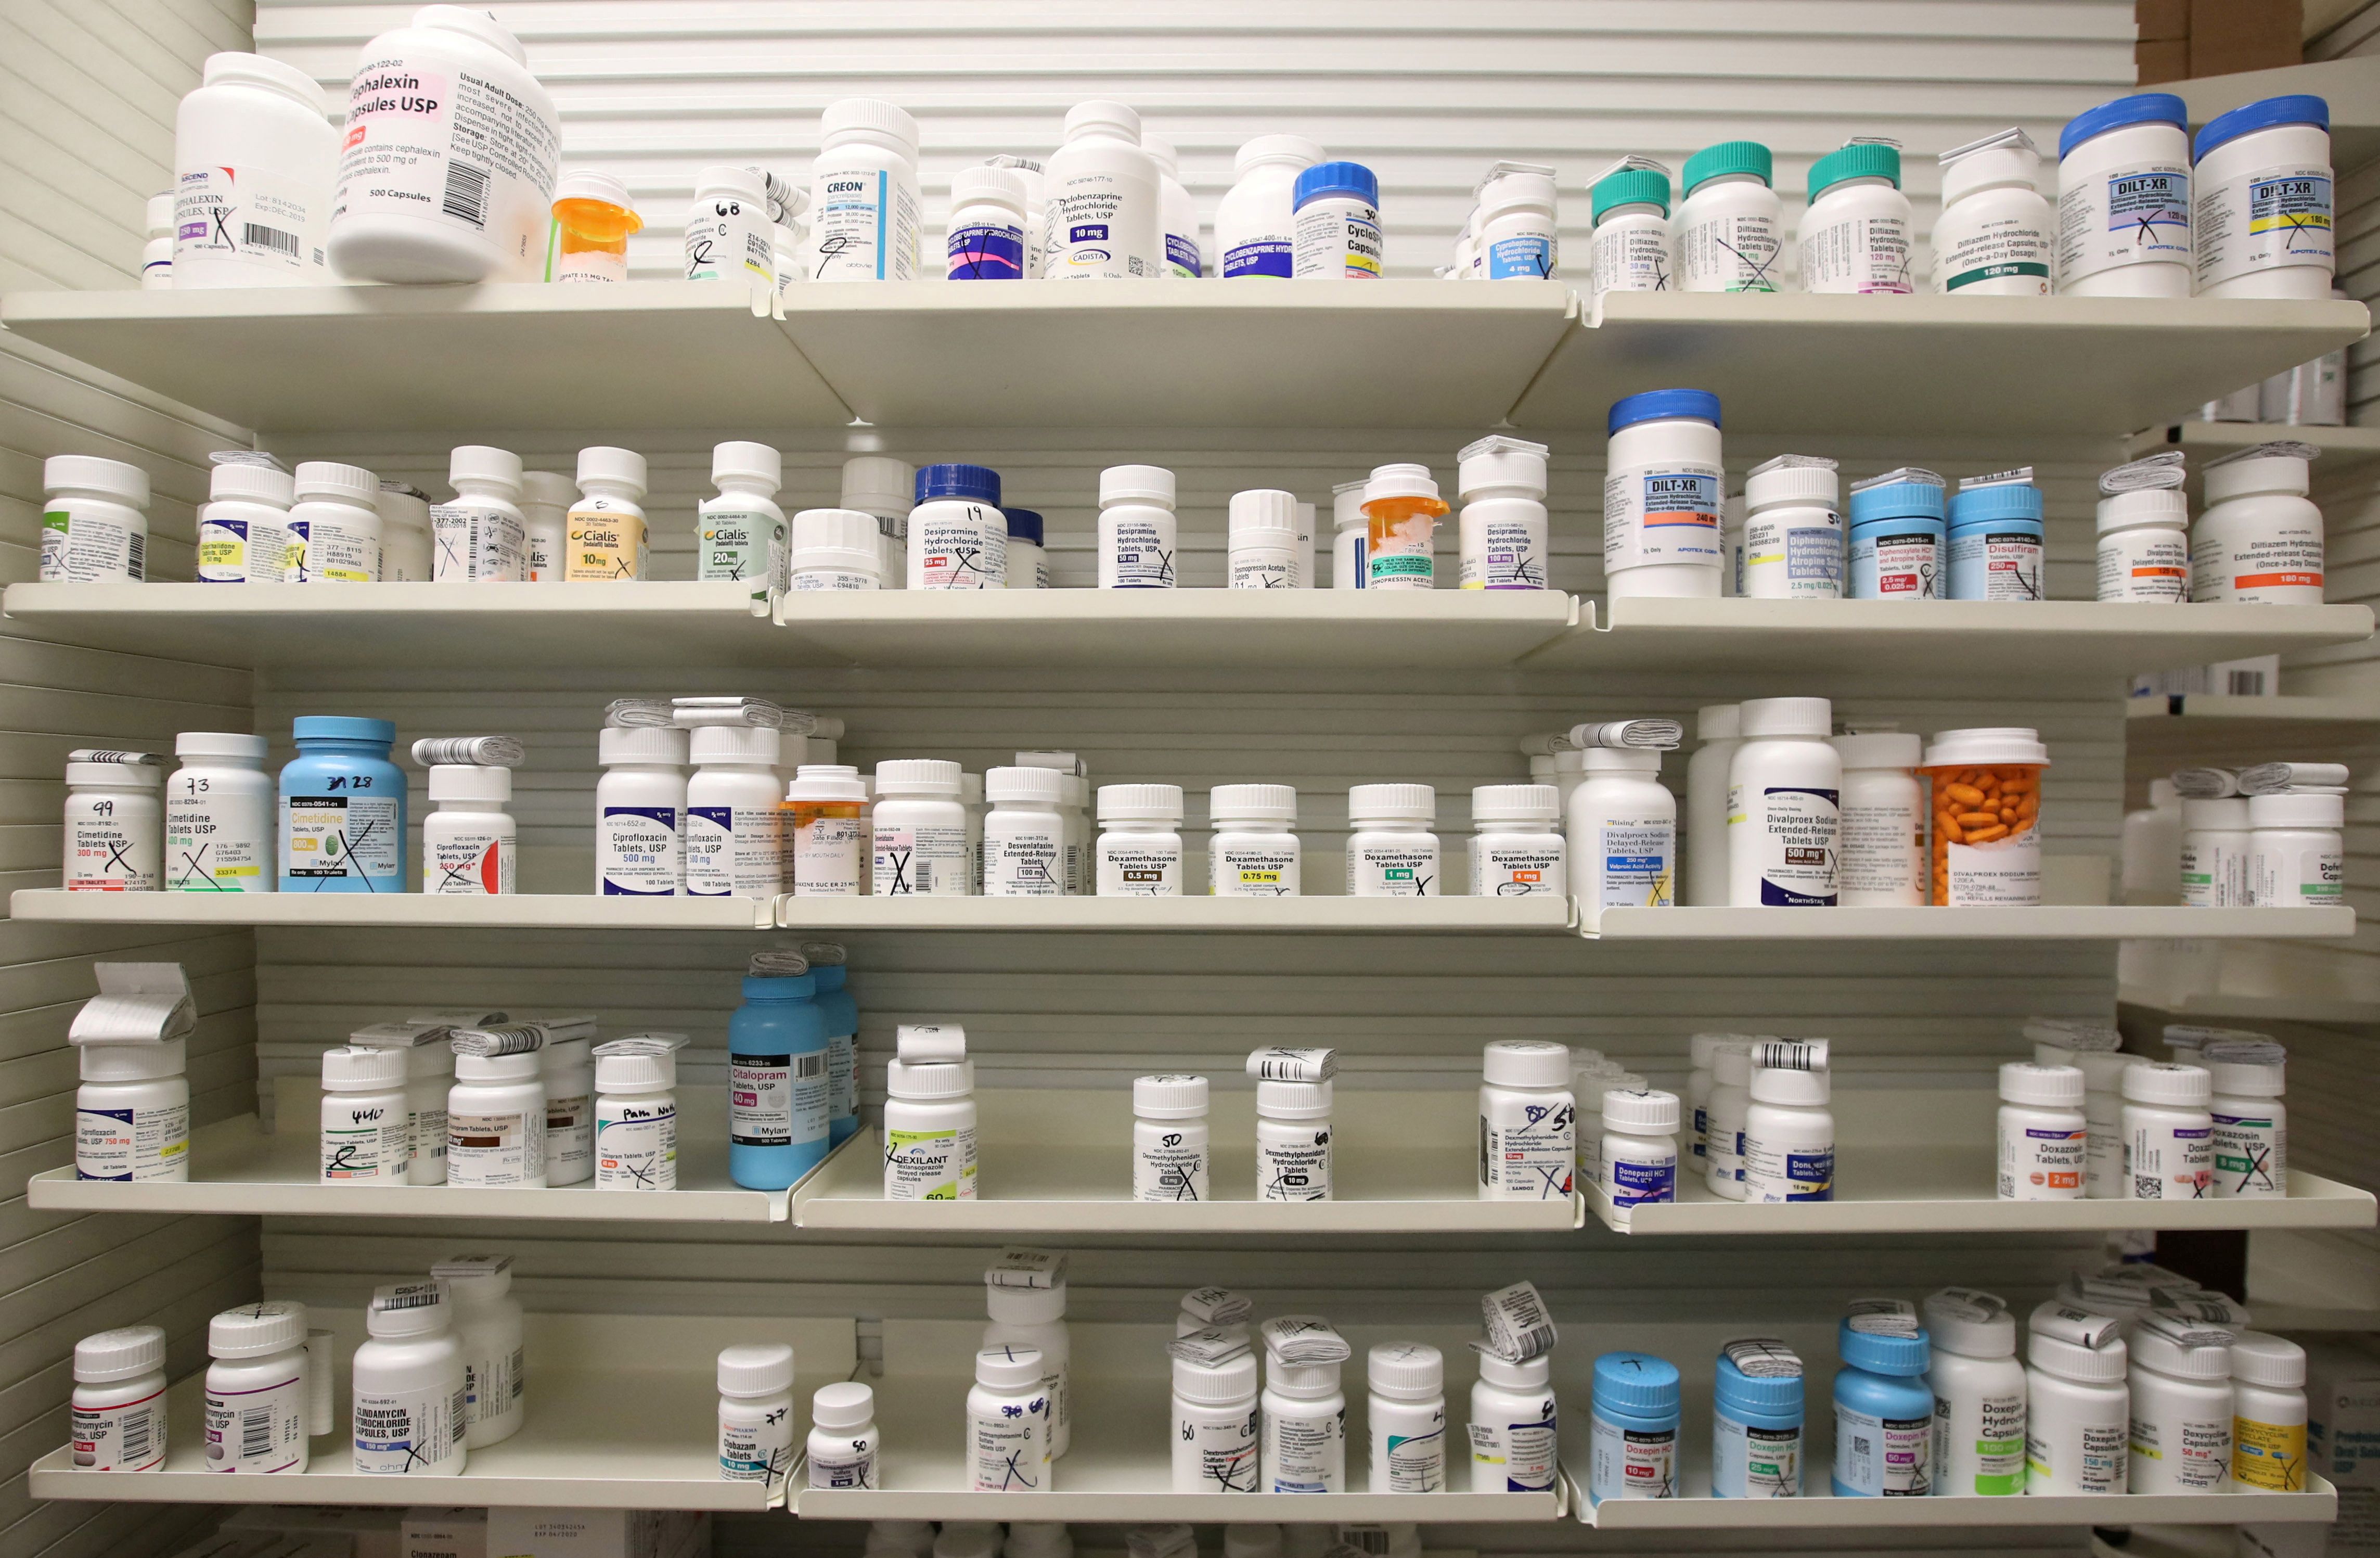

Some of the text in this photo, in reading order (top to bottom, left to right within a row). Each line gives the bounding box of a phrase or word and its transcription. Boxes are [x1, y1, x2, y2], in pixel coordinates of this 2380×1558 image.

[401, 96, 438, 114] USP
[365, 144, 440, 158] contains cephalexin
[451, 143, 518, 181] Keep tightly closed.
[828, 182, 863, 193] CREON
[2119, 178, 2168, 195] DILT-XR
[388, 189, 431, 202] Capsules
[716, 201, 740, 216] 68
[1062, 202, 1117, 215] Hydrochloride
[1066, 212, 1093, 223] Tablets,
[1075, 228, 1102, 239] 10 mg
[1870, 227, 1900, 236] Diltiazem
[1738, 234, 1778, 246] Hydrochloride
[1870, 236, 1909, 247] Hydrochloride
[1958, 229, 2040, 249] Diltiazem Hydrochloride
[1495, 239, 1541, 252] Cyproheptadine
[1497, 248, 1540, 259] Hydrochloride
[1946, 239, 2039, 264] Extended-release Capsules,
[1073, 253, 1104, 262] CADISTA
[1962, 249, 2037, 268] (Once-a-Day Dosage)
[1985, 265, 2018, 276] 120 mg
[1652, 480, 1697, 492] DILT-XR
[967, 506, 982, 521] 19
[584, 531, 617, 542] Cialis
[716, 530, 747, 540] Cialis
[924, 528, 978, 536] Desipramine
[924, 537, 983, 546] Hydrochloride
[1117, 537, 1161, 545] Hydrochloride
[1487, 537, 1531, 545] Hydrochloride
[2252, 541, 2288, 550] Diltiazem
[1880, 548, 1920, 556] Diphenoxylate
[1989, 545, 2039, 554] Disulfiram
[583, 554, 606, 566] 10 mg
[2234, 550, 2300, 561] Extended-release
[1234, 565, 1266, 574] Desmopressin
[187, 778, 209, 795] 73
[93, 801, 113, 816] 99
[292, 813, 343, 824] Cimetidine
[1769, 825, 1837, 835] Extended-Release
[613, 833, 667, 843] Ciprofloxacin
[1606, 839, 1664, 848] Delayed-Release
[613, 844, 646, 853] Tablets,
[705, 845, 722, 853] USP
[1008, 842, 1053, 850] Desvenlafaxine
[623, 854, 655, 864] 500 mg
[1144, 873, 1157, 881] mg
[733, 1069, 787, 1081] Citalopram
[733, 1081, 756, 1091] Tablets,
[762, 1127, 787, 1135] Mylan
[1162, 1134, 1182, 1147] 50
[1142, 1153, 1200, 1161] Dexmethylphenidate
[1265, 1149, 1326, 1159] Dexmethylphenidate
[897, 1156, 948, 1164] DEXILANT
[1619, 1167, 1653, 1178] Donepezil
[357, 1407, 406, 1418] CLINDAMYCIN
[1983, 1403, 2022, 1415] Doxepin
[216, 1420, 229, 1429] USP
[355, 1417, 411, 1428] HYDROCHLORIDE
[89, 1431, 107, 1440] USP
[356, 1427, 410, 1439] CAPSULES, USP
[1182, 1420, 1194, 1440] 60
[2183, 1428, 2227, 1439] Doxycycline
[1886, 1431, 1921, 1441] Doxepin
[724, 1438, 756, 1450] Clobazam
[1750, 1441, 1784, 1452] Doxepin
[727, 1449, 751, 1460] Tablets
[1627, 1445, 1659, 1455] Doxepin
